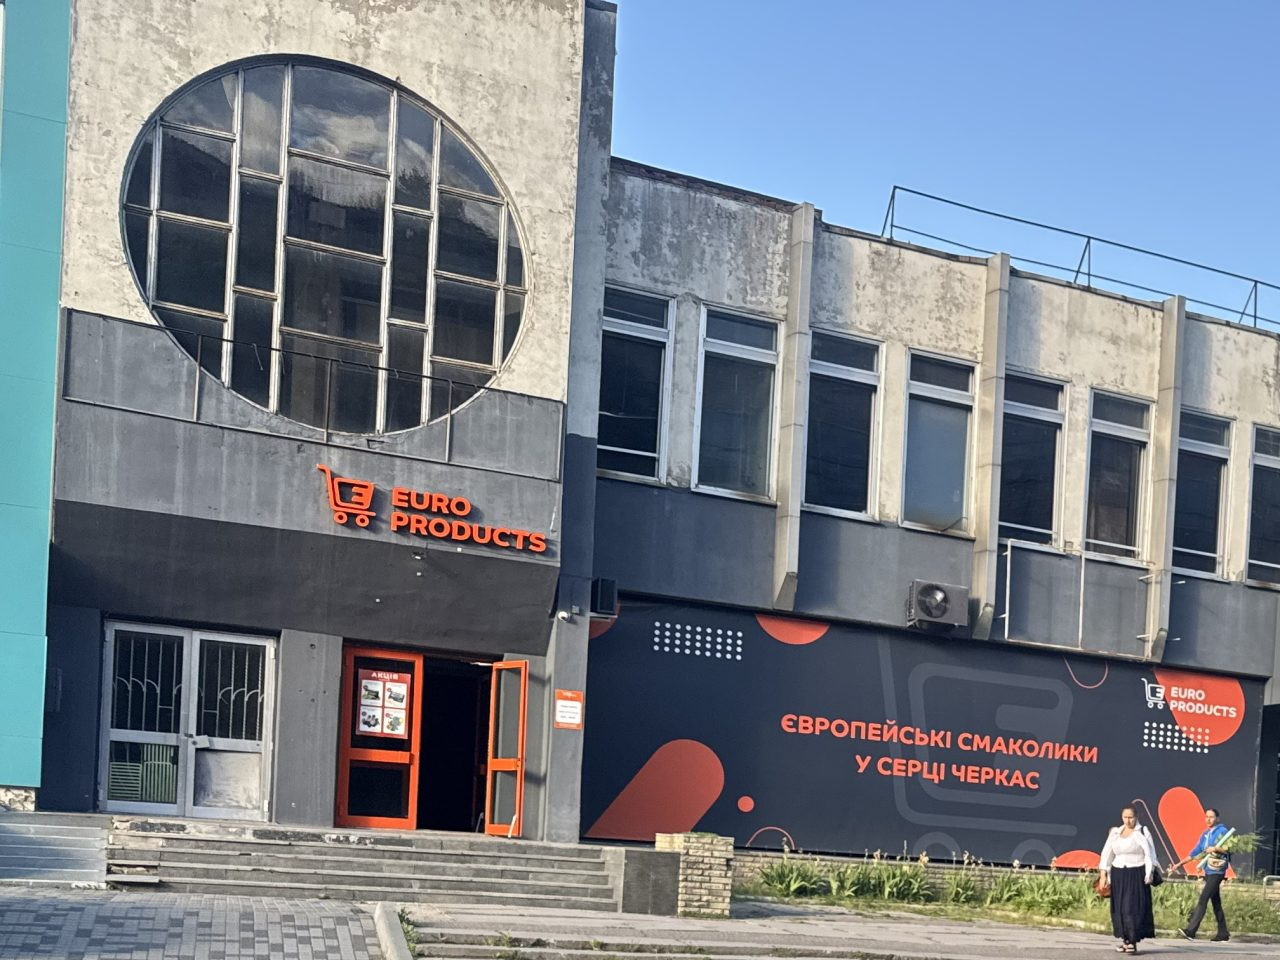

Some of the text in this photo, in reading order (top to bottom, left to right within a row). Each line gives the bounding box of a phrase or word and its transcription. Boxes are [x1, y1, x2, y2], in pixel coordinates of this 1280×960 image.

[391, 486, 472, 517] EURO
[390, 511, 548, 553] PRODUCTS
[1169, 700, 1237, 718] PRODUCTS
[1170, 686, 1206, 701] EURO
[780, 713, 1098, 764] ЄВРОПЕЙСЬКІ СМАКОЛИКИ
[855, 755, 1041, 789] У СЕРЦІ ЧЕРКАС
